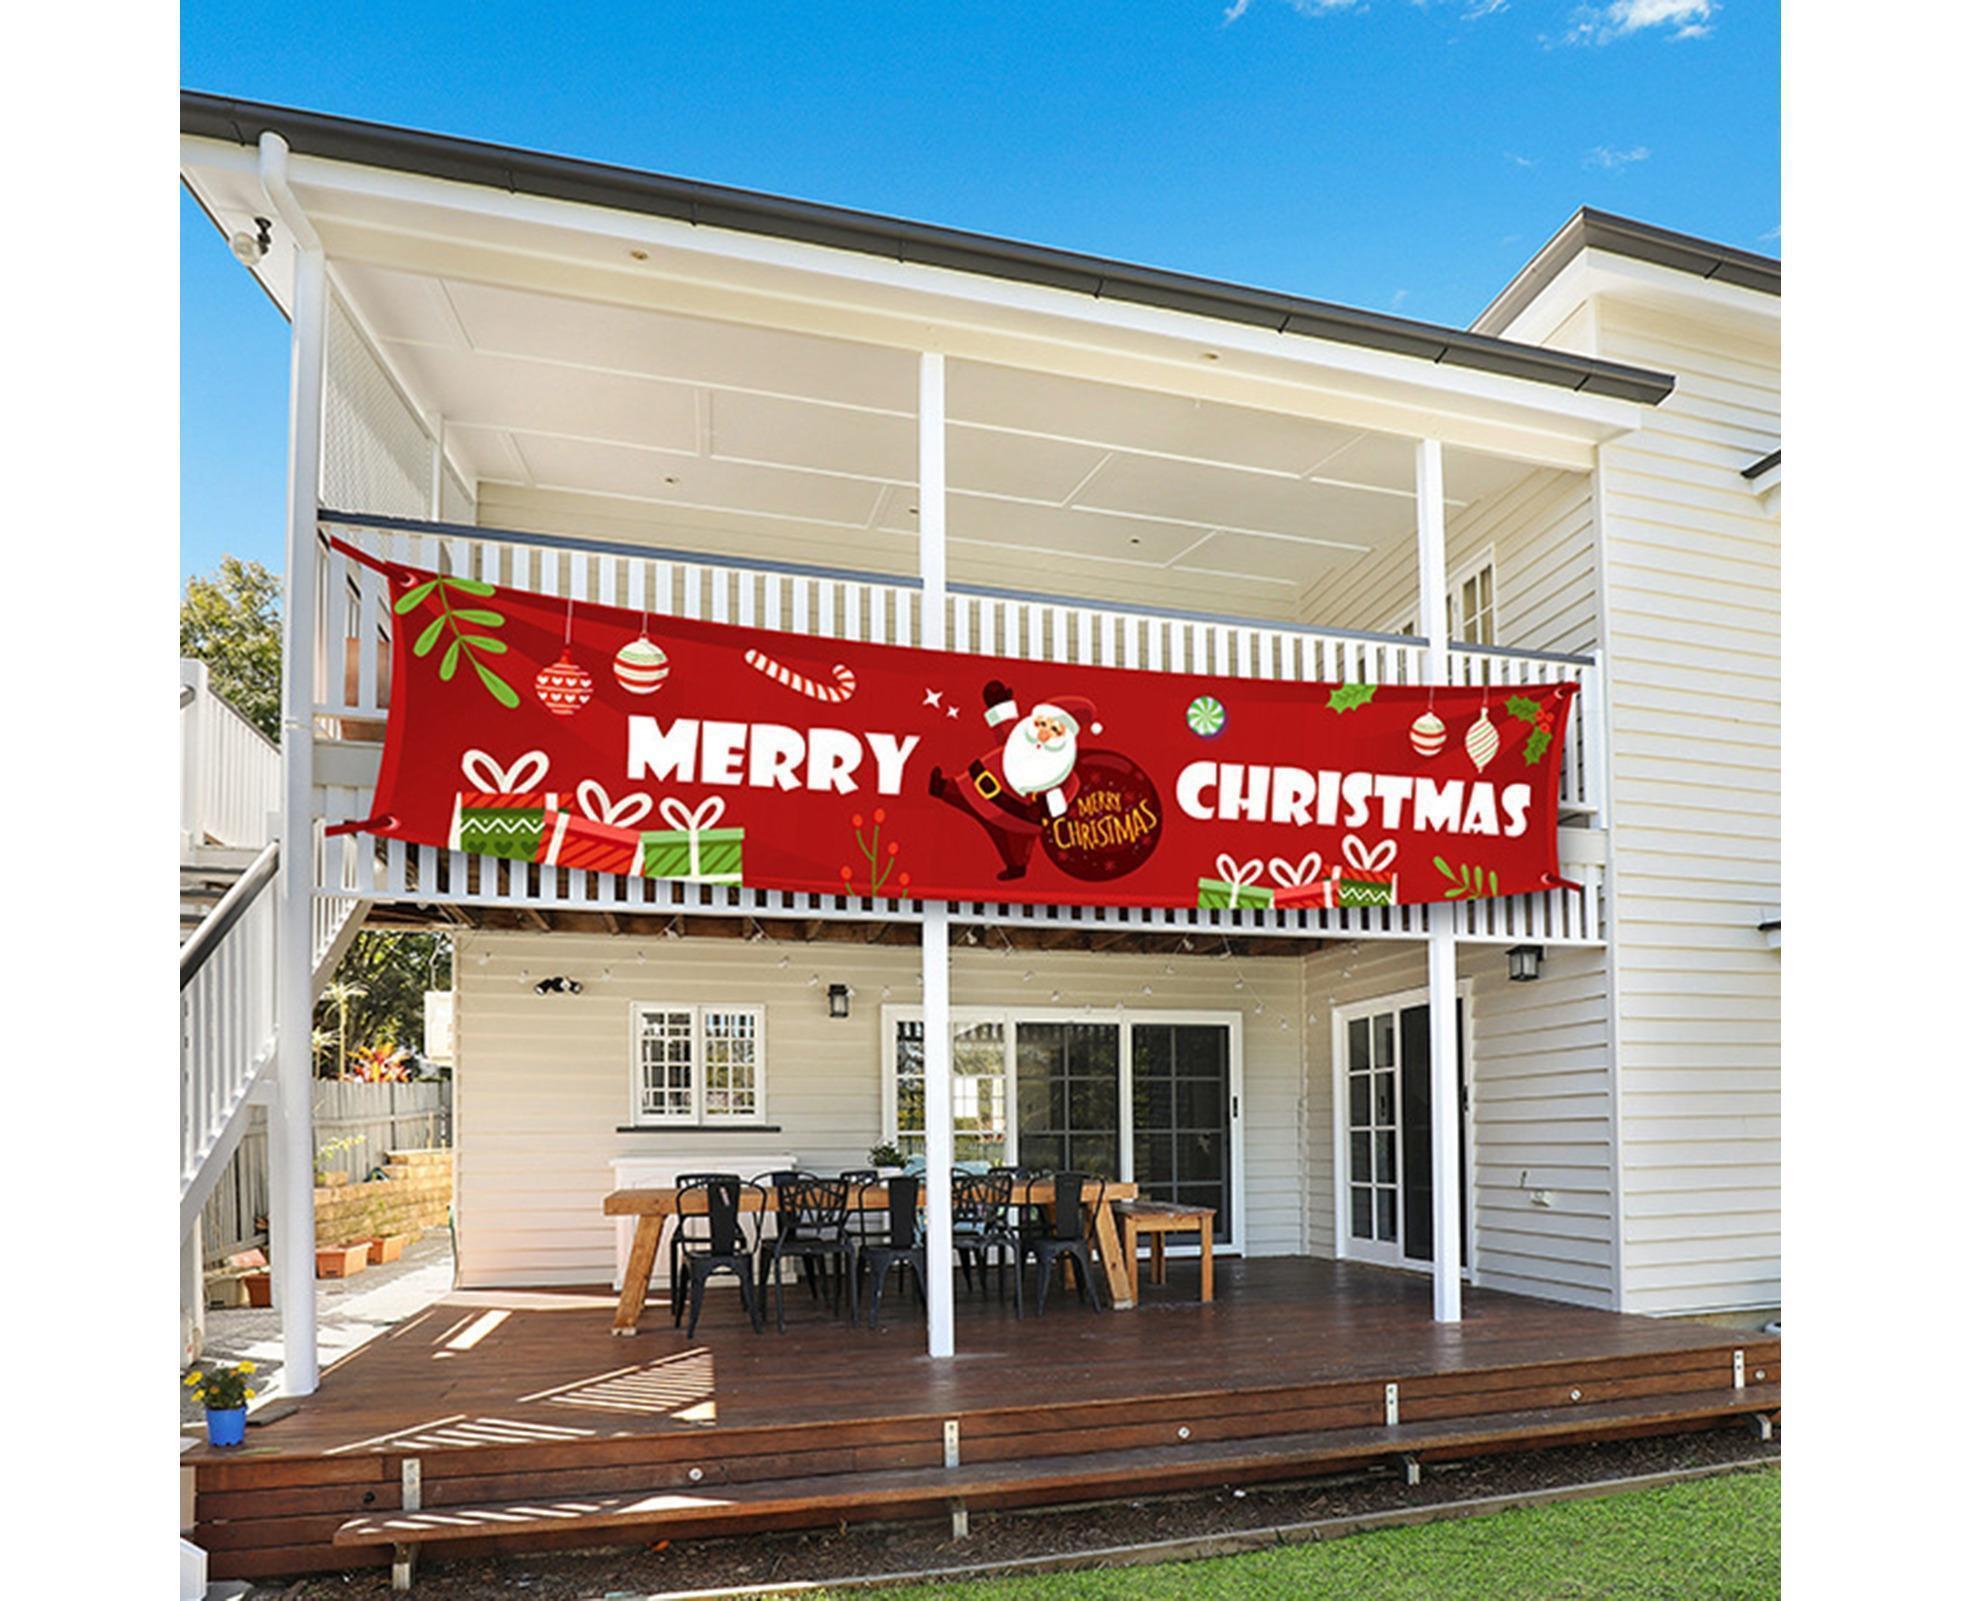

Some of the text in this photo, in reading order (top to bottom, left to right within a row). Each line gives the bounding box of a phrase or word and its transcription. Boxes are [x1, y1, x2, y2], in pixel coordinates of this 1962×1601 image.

[627, 715, 1531, 837] MERRY CHRISTMAS
[1053, 799, 1157, 850] CHRISTMAS
[1077, 791, 1122, 816] MERRY
